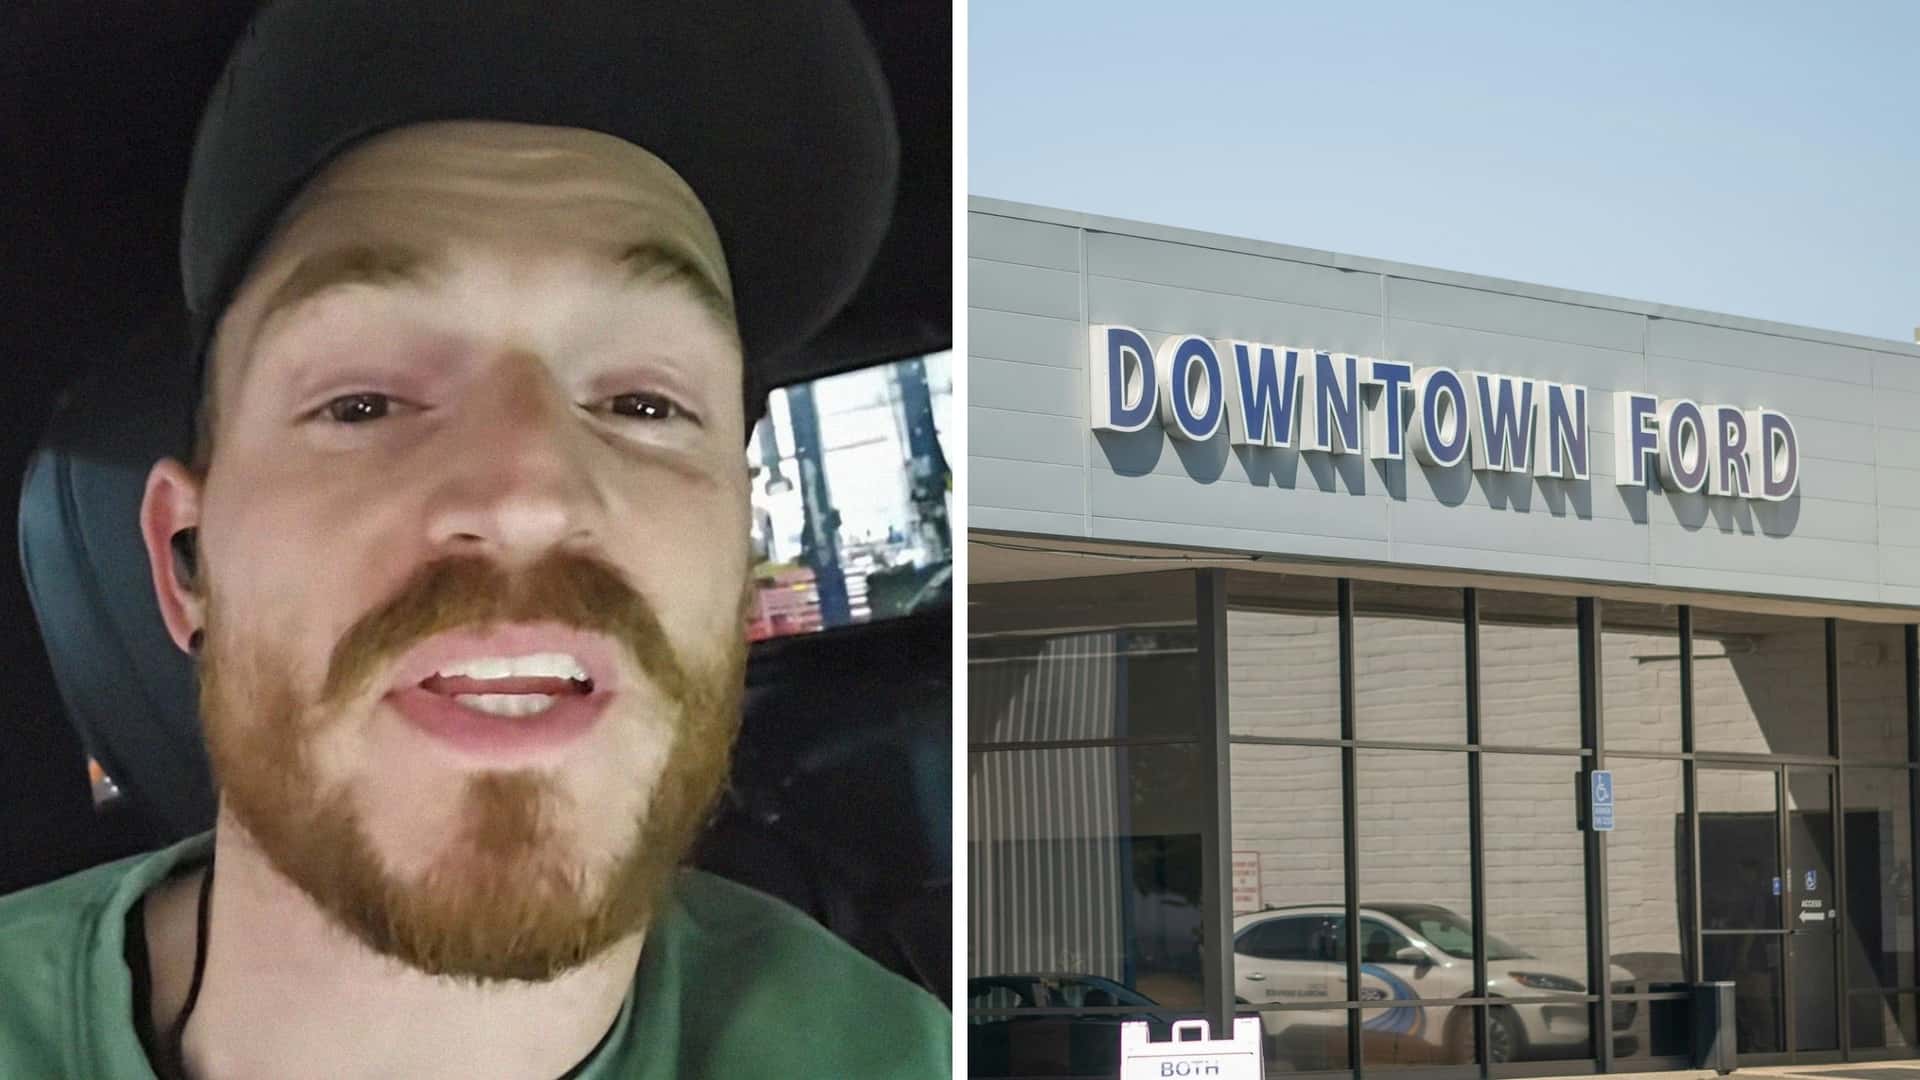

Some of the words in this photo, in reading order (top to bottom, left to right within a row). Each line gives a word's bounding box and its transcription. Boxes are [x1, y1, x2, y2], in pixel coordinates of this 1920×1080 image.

[1091, 325, 1589, 480] DOWNTOWN
[1613, 391, 1798, 501] FORD
[1161, 1060, 1219, 1077] BOTH
